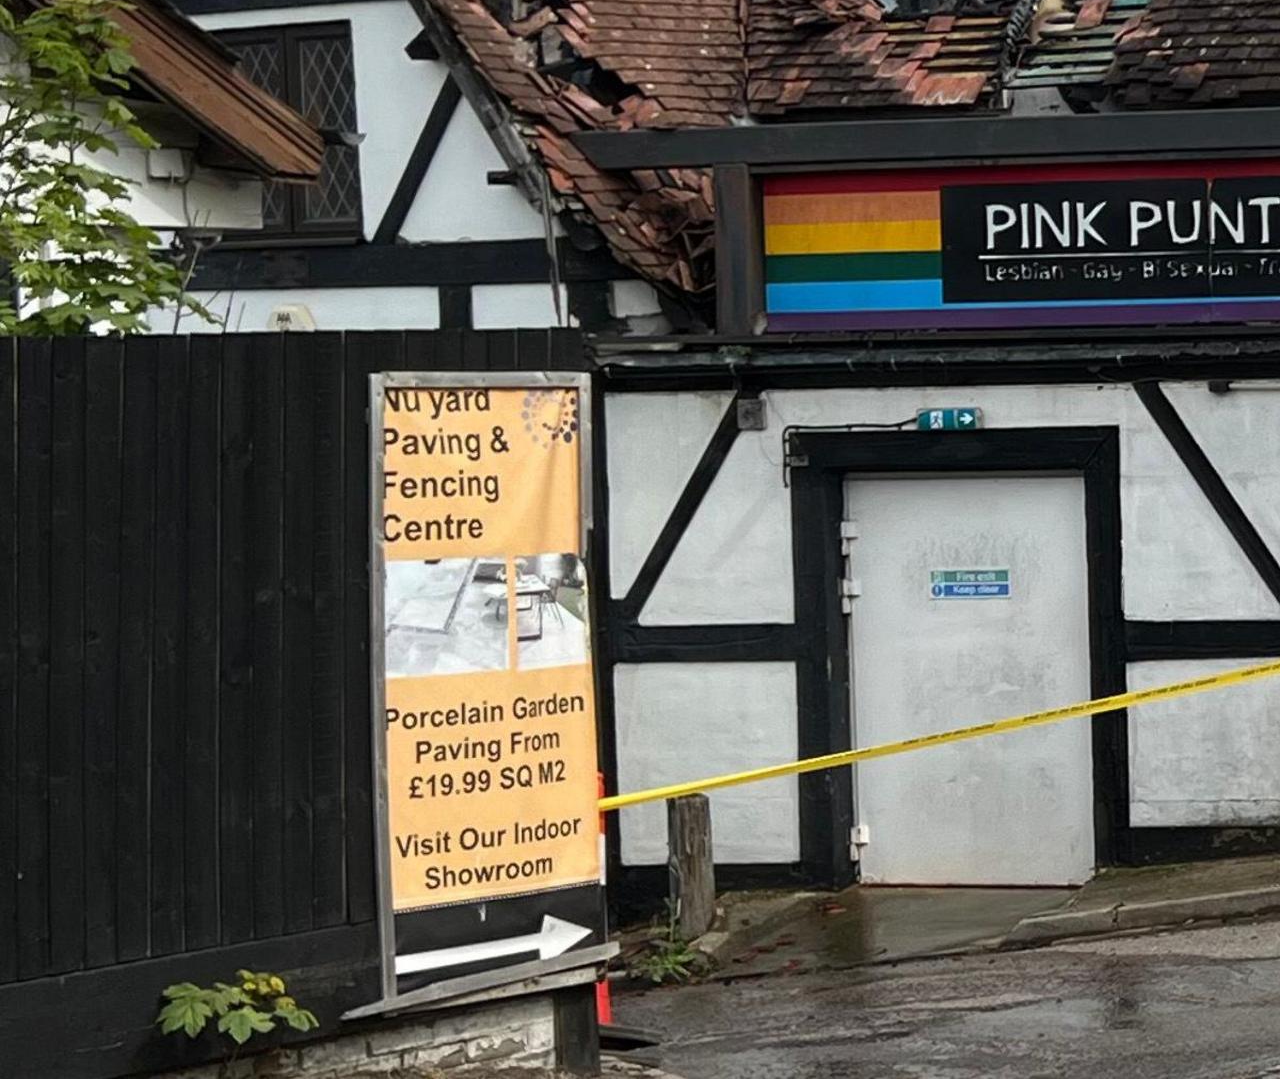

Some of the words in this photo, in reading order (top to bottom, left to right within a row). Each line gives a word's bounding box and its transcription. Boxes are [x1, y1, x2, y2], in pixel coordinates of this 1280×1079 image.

[984, 199, 1107, 250] PINK
[984, 261, 1064, 282] Lesbian
[1082, 261, 1123, 280] Gay
[429, 389, 491, 419] yard
[384, 427, 481, 461] Paving
[490, 426, 510, 453] &
[383, 469, 500, 503] Fencing
[383, 512, 484, 542] Centre
[385, 701, 504, 731] Porcelain
[512, 693, 584, 721] Garden
[415, 737, 501, 764] Paving
[510, 730, 560, 755] From
[409, 770, 491, 799] £19.99
[500, 765, 533, 789] SQ
[538, 759, 566, 785] M2
[396, 832, 451, 858] Visit
[459, 827, 507, 850] Our
[514, 816, 582, 845] Indoor
[424, 856, 553, 890] Showroom
